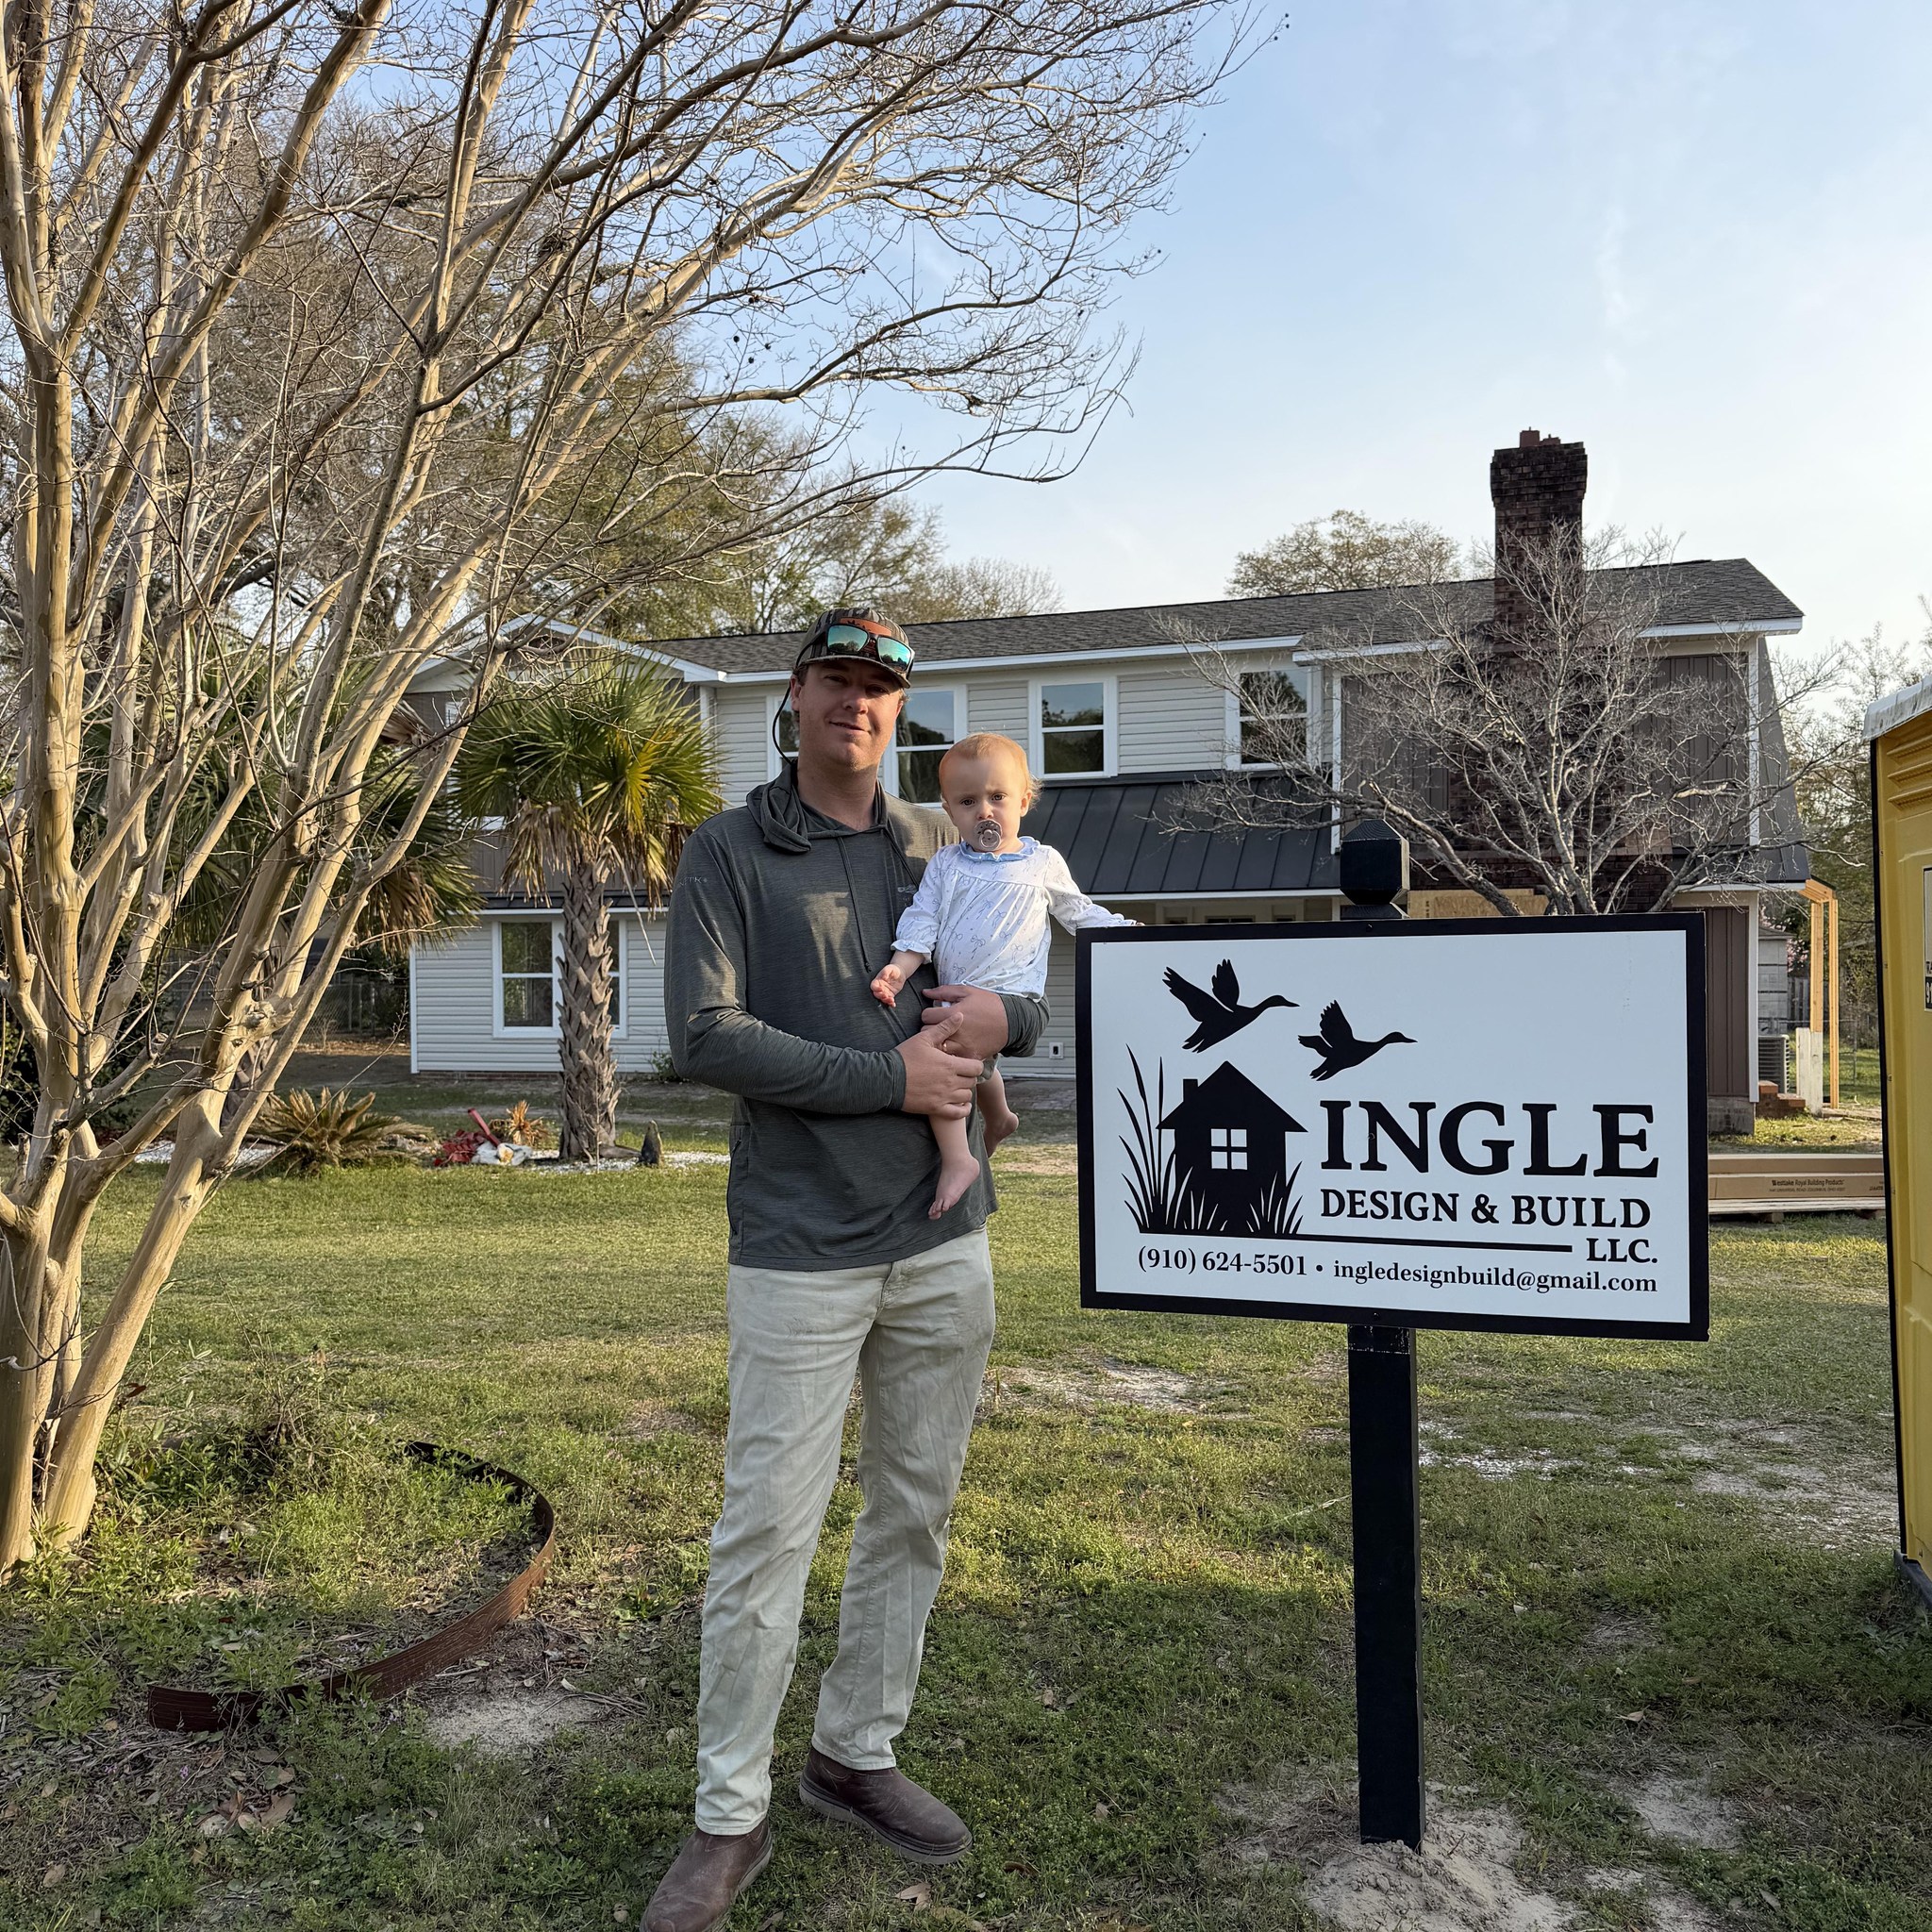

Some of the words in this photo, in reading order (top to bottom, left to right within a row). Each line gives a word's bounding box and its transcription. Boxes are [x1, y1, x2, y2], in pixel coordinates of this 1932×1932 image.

[1319, 1100, 1659, 1178] INGLE
[1320, 1188, 1460, 1223] DESIGN
[1471, 1193, 1500, 1224] &
[1510, 1194, 1651, 1228] BUILD
[1138, 1245, 1196, 1275] (910)
[1202, 1251, 1307, 1275] 624-5501
[1333, 1259, 1657, 1294] ingledesignbuild@gmail.com
[1586, 1237, 1658, 1264] LLC.
